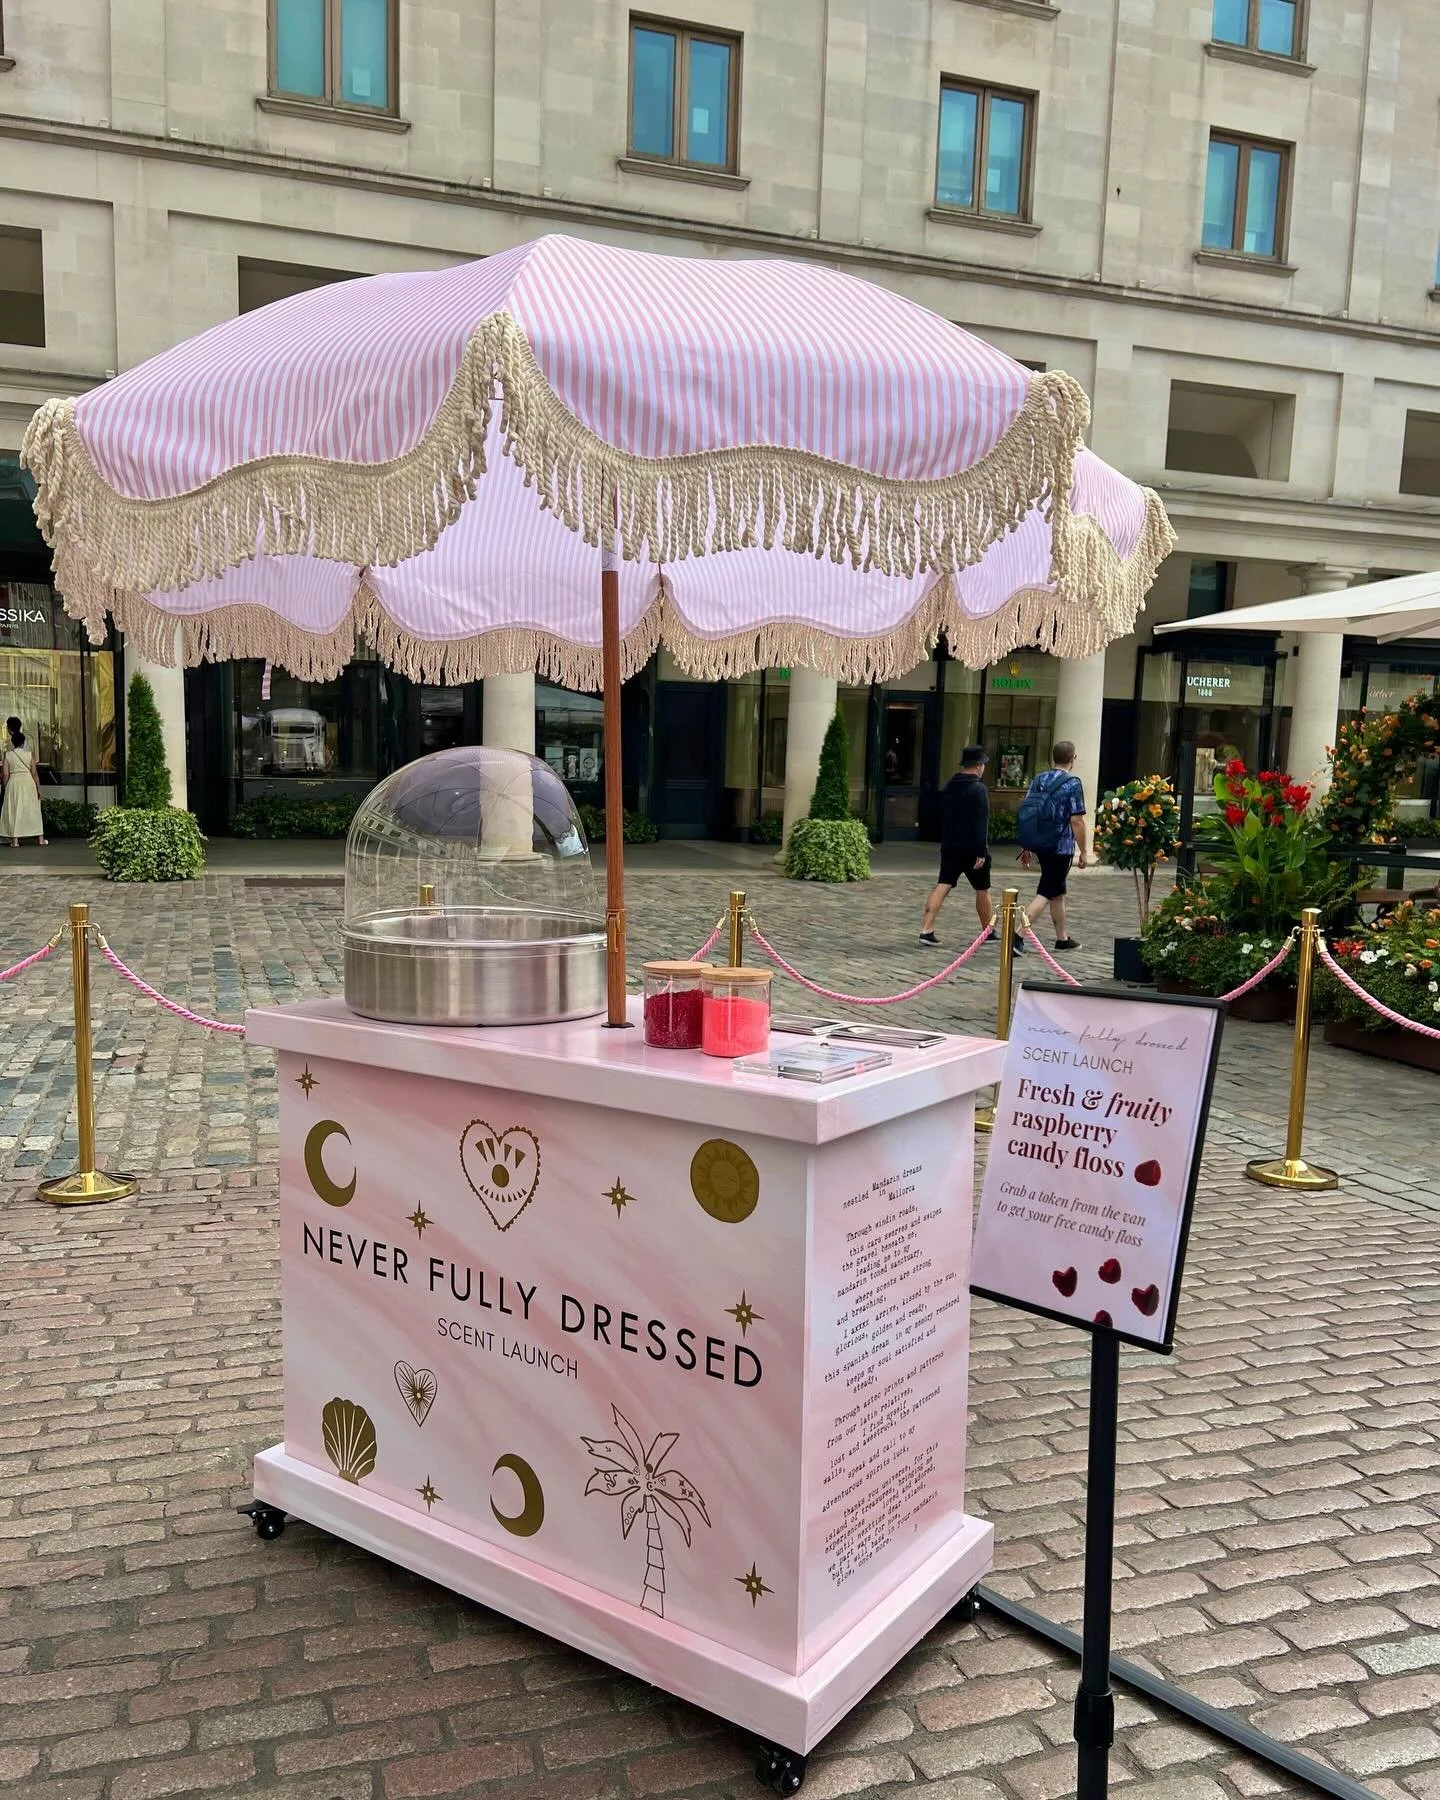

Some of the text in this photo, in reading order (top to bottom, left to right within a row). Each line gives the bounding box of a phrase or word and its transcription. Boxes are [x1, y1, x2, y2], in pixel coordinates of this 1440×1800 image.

[1023, 1047, 1133, 1075] SCENT LAUNCH
[1079, 1025, 1127, 1052] fully
[1017, 1078, 1173, 1127] Fresh & fruity
[1012, 1111, 1118, 1149] raspberry
[1008, 1139, 1126, 1178] candy floss
[996, 1200, 1144, 1248] to get your free candy floss
[1000, 1181, 1146, 1227] Grab a token from the van
[303, 1220, 763, 1388] NEVER FULLY DRESSED
[437, 1317, 578, 1380] SCENT LAUNCH
